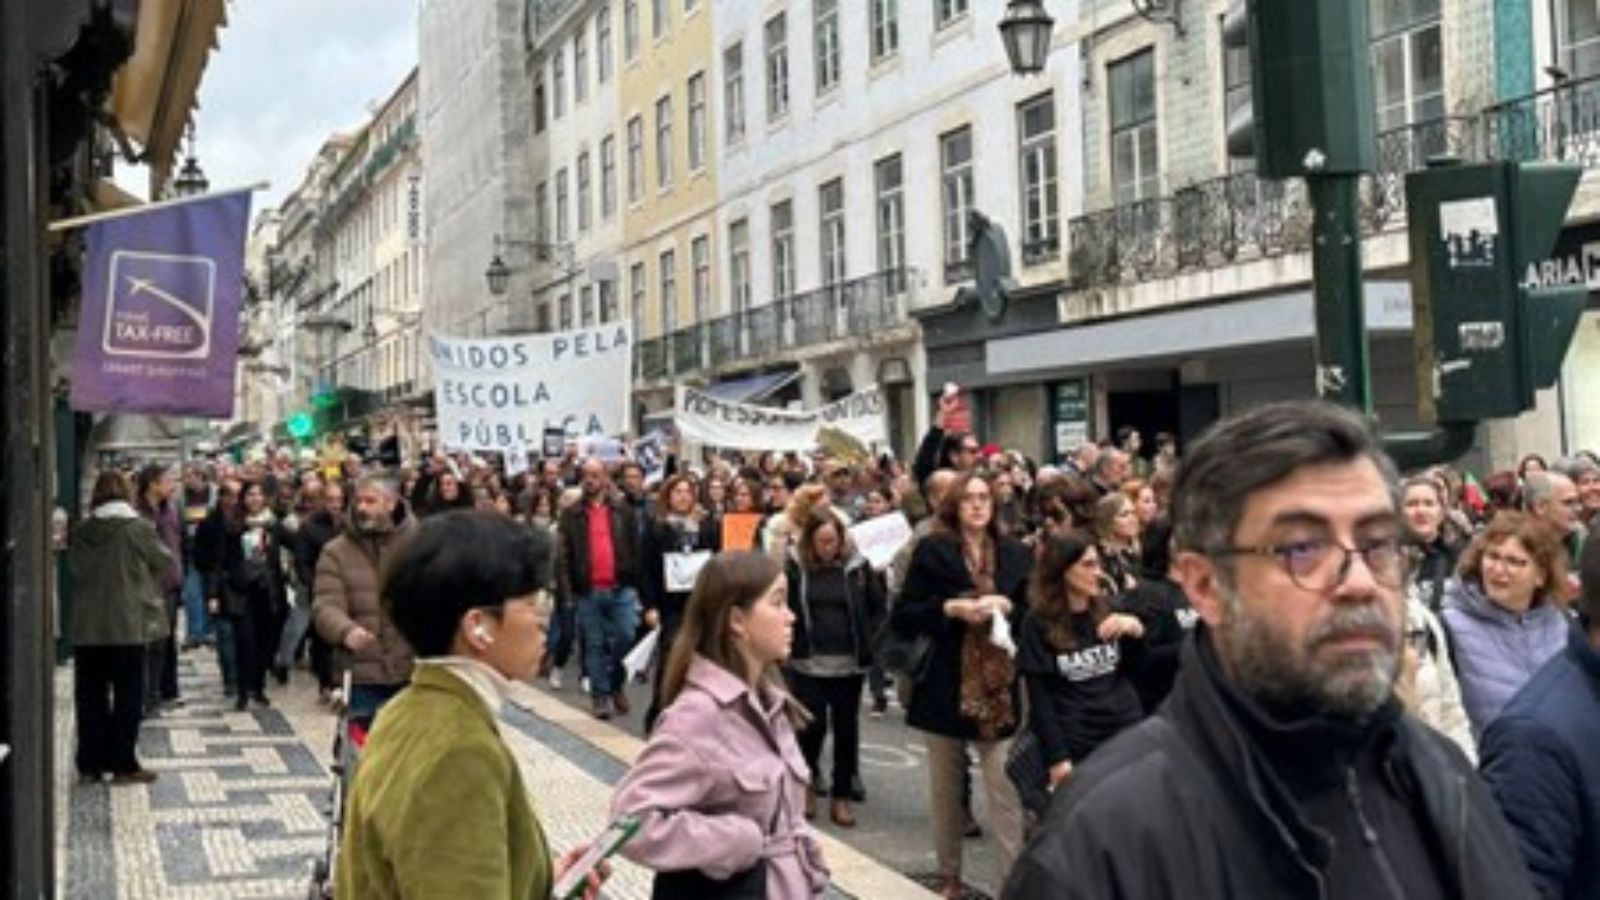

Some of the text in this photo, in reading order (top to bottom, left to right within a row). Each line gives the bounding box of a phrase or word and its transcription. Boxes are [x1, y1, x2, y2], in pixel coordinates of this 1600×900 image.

[1518, 255, 1582, 287] ARIA
[116, 322, 193, 344] TAX-FREE
[552, 328, 627, 361] PELA
[443, 381, 551, 408] ESCOLA
[460, 414, 604, 447] PÚBLCA
